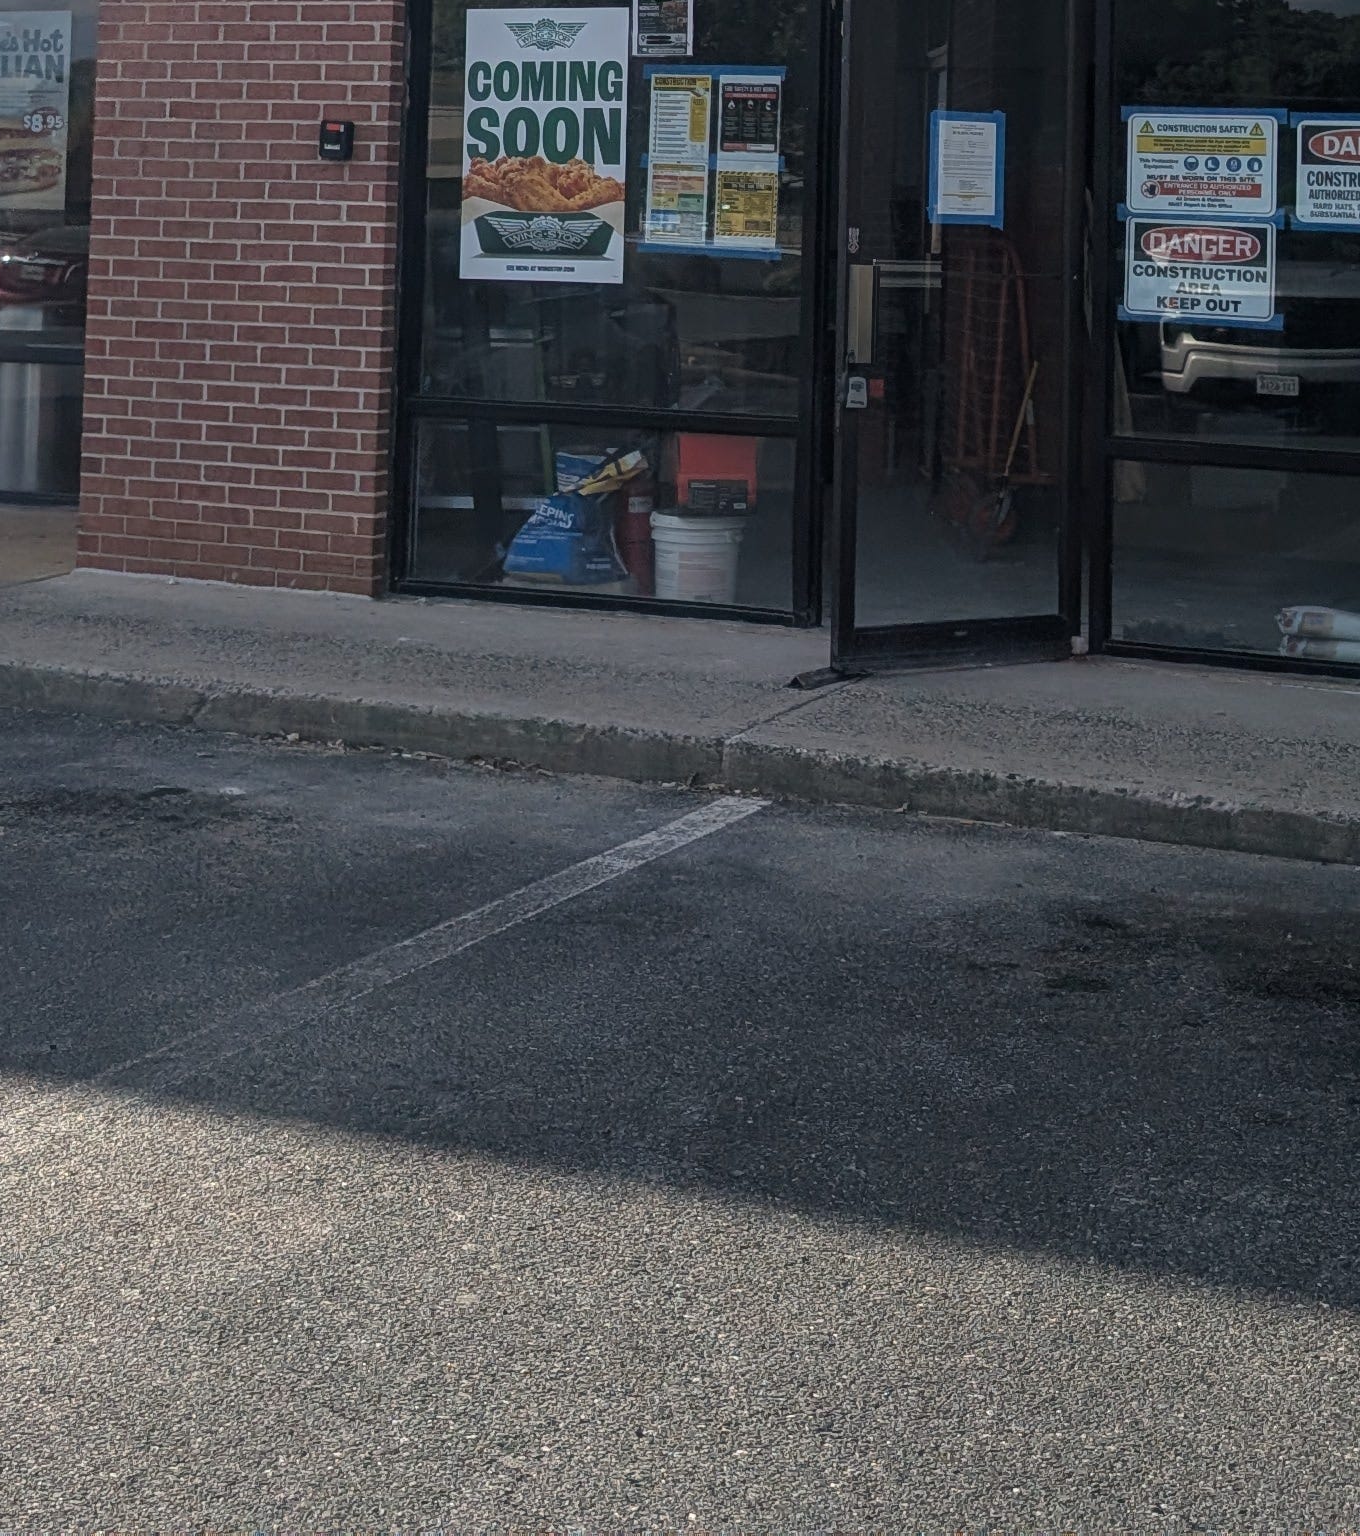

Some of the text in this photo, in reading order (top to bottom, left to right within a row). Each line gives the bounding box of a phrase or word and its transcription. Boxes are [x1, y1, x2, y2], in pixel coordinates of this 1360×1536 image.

[22, 29, 63, 52] Hot
[468, 60, 624, 101] COMING
[23, 113, 65, 133] $8.95
[1157, 124, 1249, 134] CONSTRUCTION SAFETY
[466, 107, 622, 165] SOON
[1308, 189, 1360, 201] AUTHORIZED
[1310, 211, 1357, 219] SUBSTANTIAL
[1149, 232, 1252, 257] DANGER
[1132, 264, 1268, 284] CONSTRUCTION
[1175, 281, 1222, 296] AREA
[1156, 296, 1242, 313] KEEP OUT
